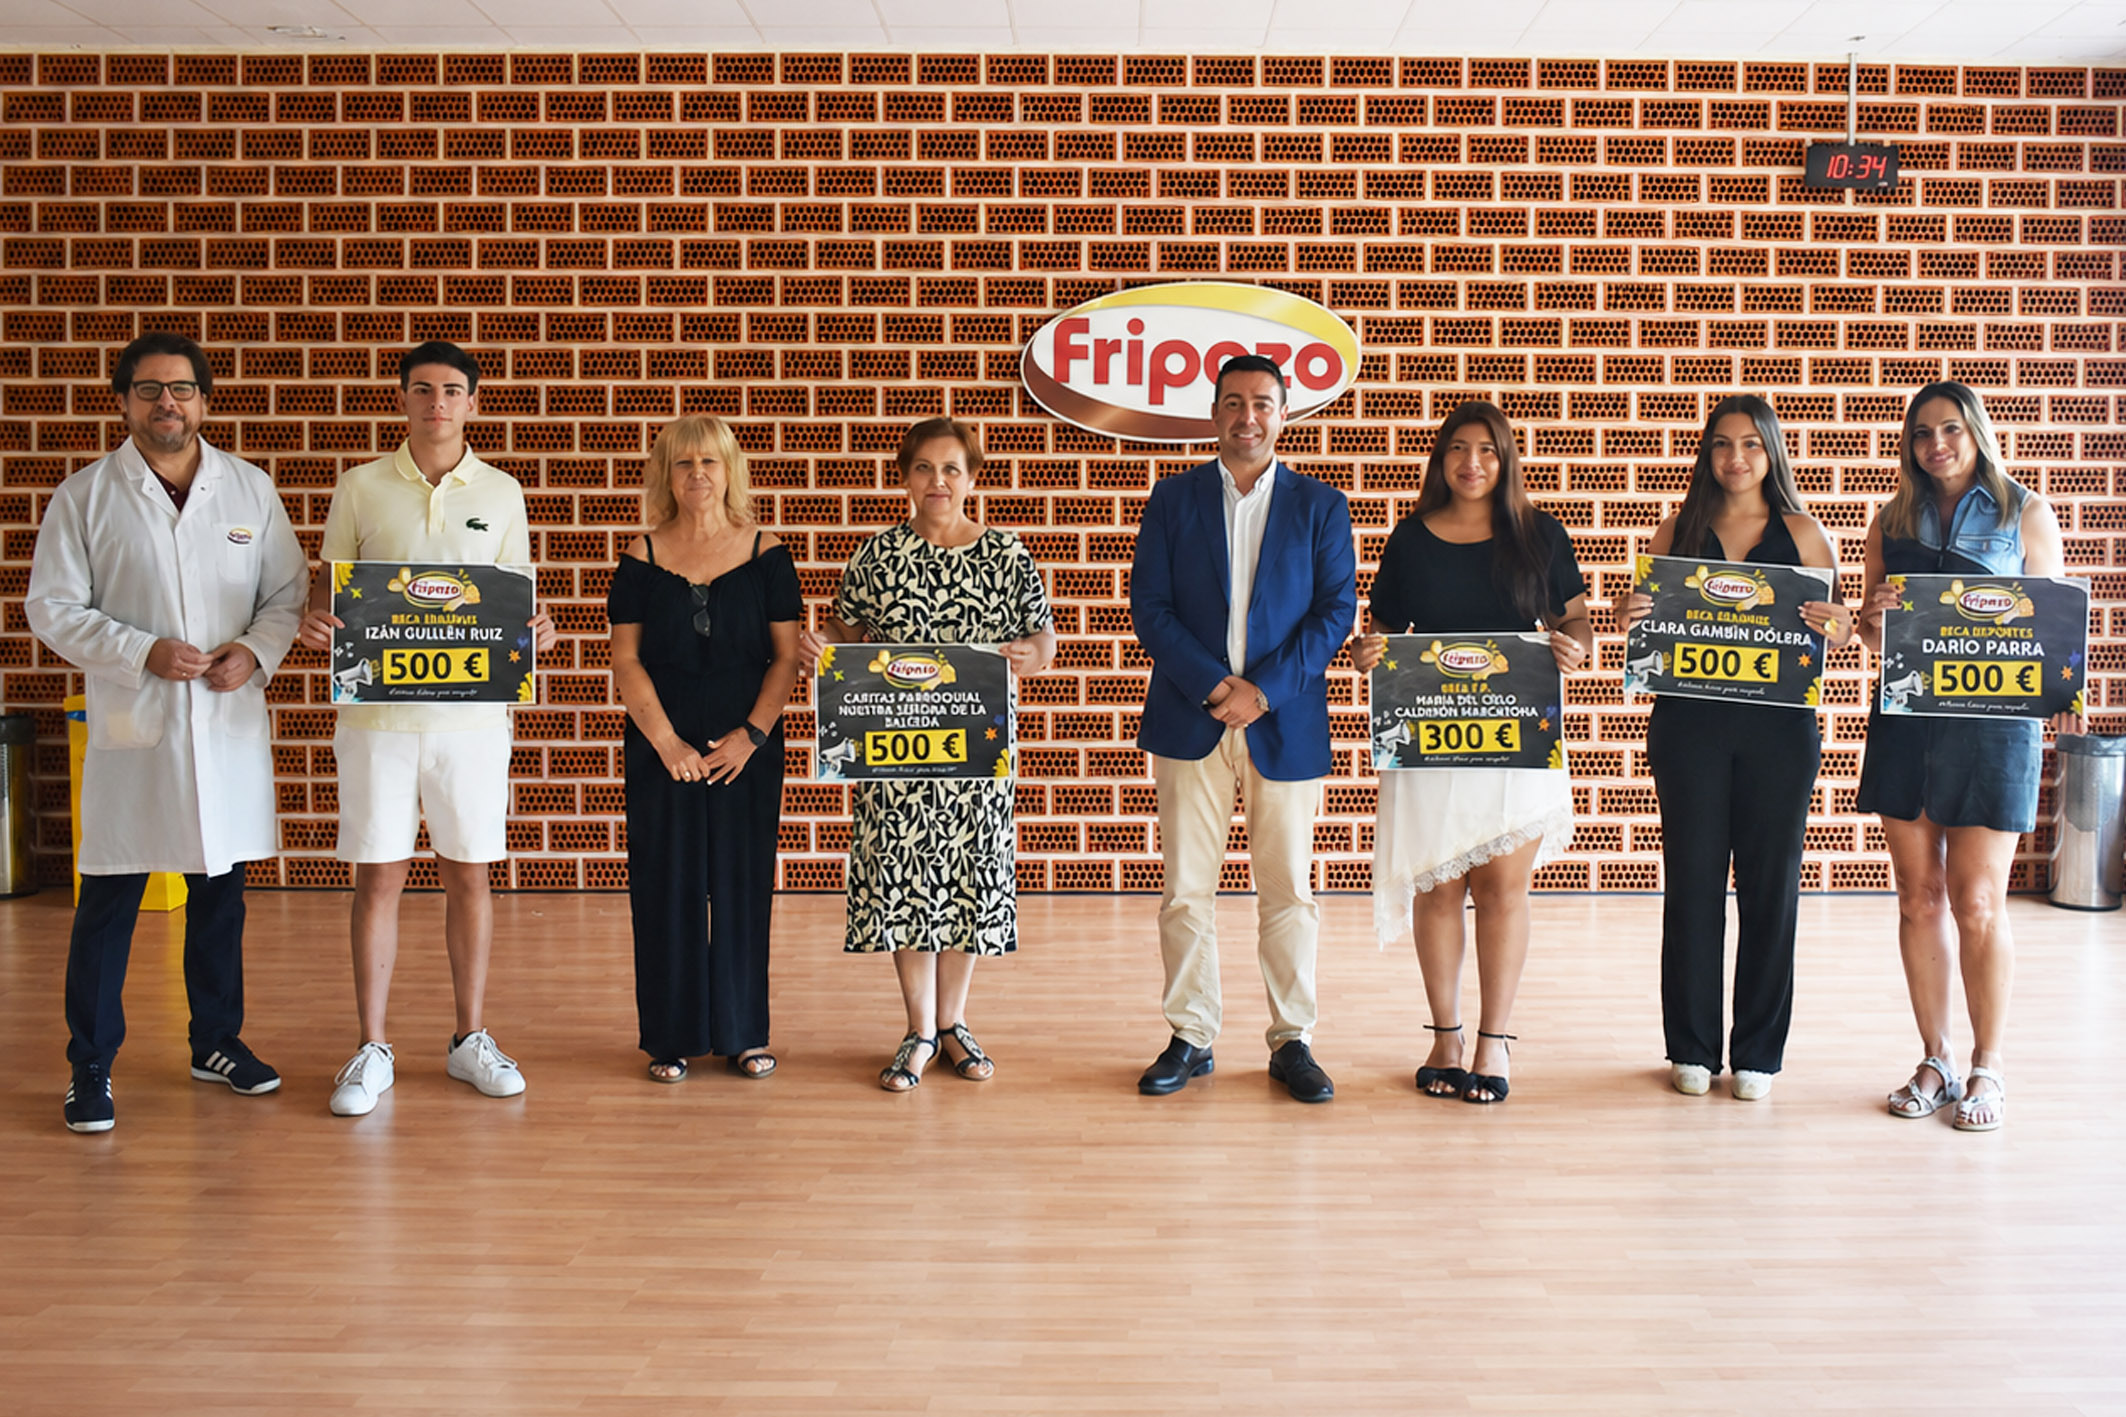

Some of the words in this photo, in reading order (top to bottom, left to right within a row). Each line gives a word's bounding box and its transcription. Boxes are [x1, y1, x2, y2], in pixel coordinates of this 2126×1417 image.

[1826, 154, 1887, 179] 10:34
[365, 624, 400, 640] IZÁN
[470, 627, 503, 641] RUIZ
[1641, 620, 1686, 637] CLARA
[1753, 627, 1813, 646] DÓLERA
[1985, 641, 2045, 657] PARRA
[390, 652, 452, 681] 500
[463, 652, 483, 679] €
[1680, 647, 1741, 678] 500
[1753, 652, 1772, 679] €
[1940, 664, 2004, 693] 500
[2015, 665, 2036, 693] €
[971, 703, 987, 716] LA
[872, 734, 930, 762] 500
[942, 732, 960, 759] €
[1425, 723, 1484, 750] 300
[1495, 723, 1514, 749] €
